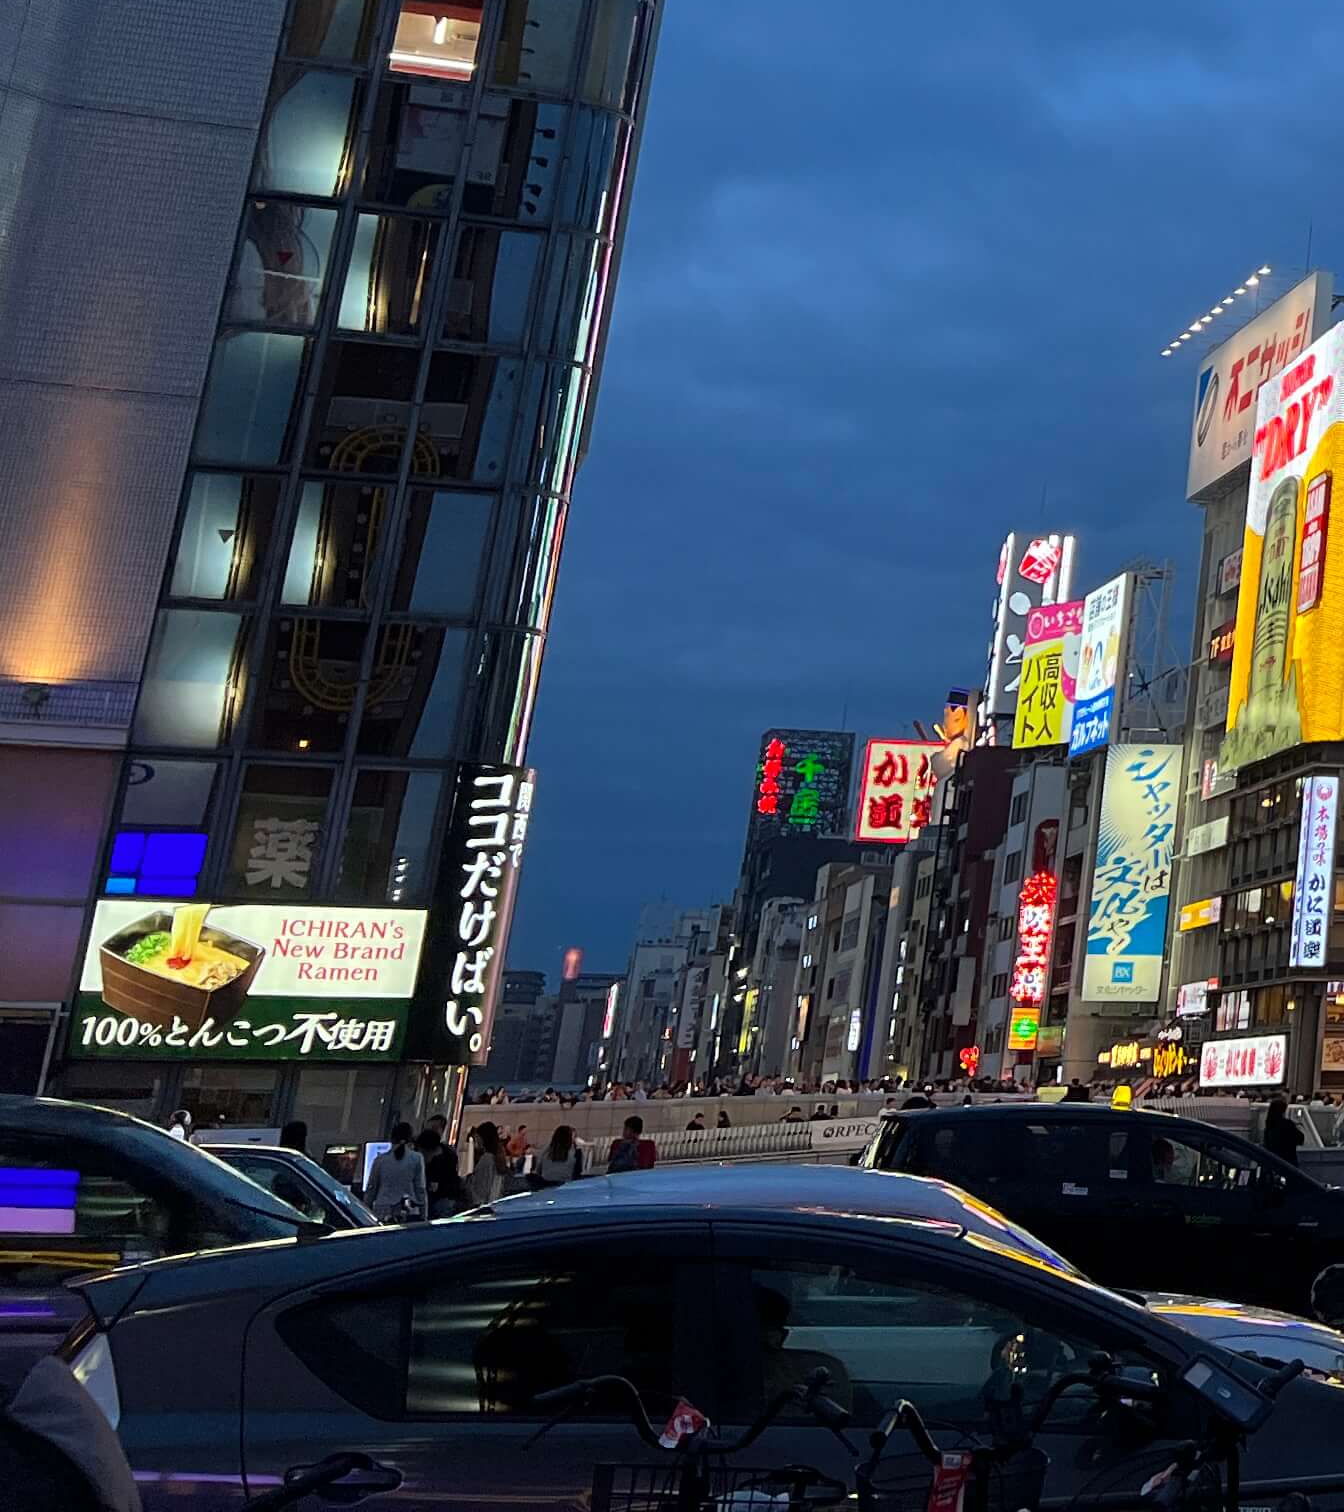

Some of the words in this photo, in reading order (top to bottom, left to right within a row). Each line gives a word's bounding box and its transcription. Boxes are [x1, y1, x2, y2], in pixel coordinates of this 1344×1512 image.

[1021, 657, 1042, 743] バイト
[1036, 653, 1062, 739] 高収入
[245, 817, 319, 889] 薬
[1125, 749, 1175, 894] シャッターは
[272, 938, 325, 959] New
[334, 941, 405, 961] Brand
[281, 919, 404, 941] ICHIRAN's
[1304, 873, 1326, 960] かに道楽
[297, 963, 378, 983] Ramen
[80, 1012, 397, 1054] 100%とんこつ不使用
